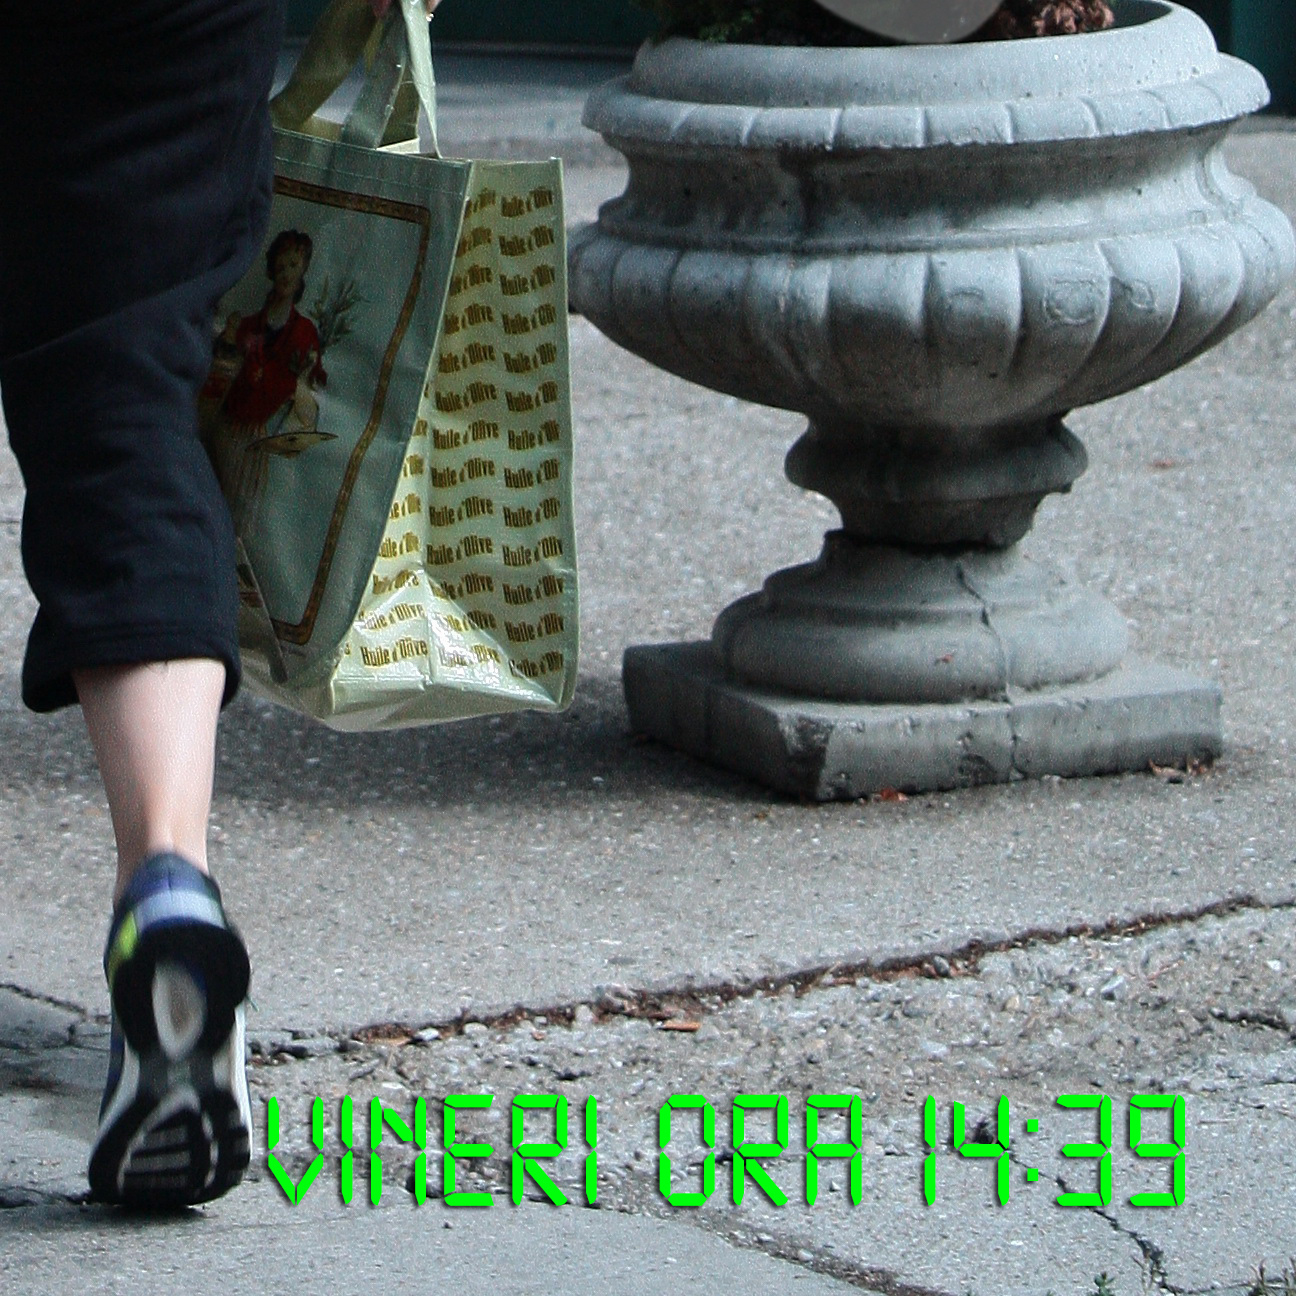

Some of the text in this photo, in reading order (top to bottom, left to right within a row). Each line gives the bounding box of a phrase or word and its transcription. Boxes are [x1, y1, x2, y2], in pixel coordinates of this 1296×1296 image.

[432, 419, 500, 450] Huile d'Olive
[430, 457, 496, 489] Huile d'Olive
[429, 496, 494, 528] Huile d'Olive
[426, 535, 494, 566] Huile d'Olive
[360, 645, 391, 668] Huile
[391, 636, 429, 663] d'Olive
